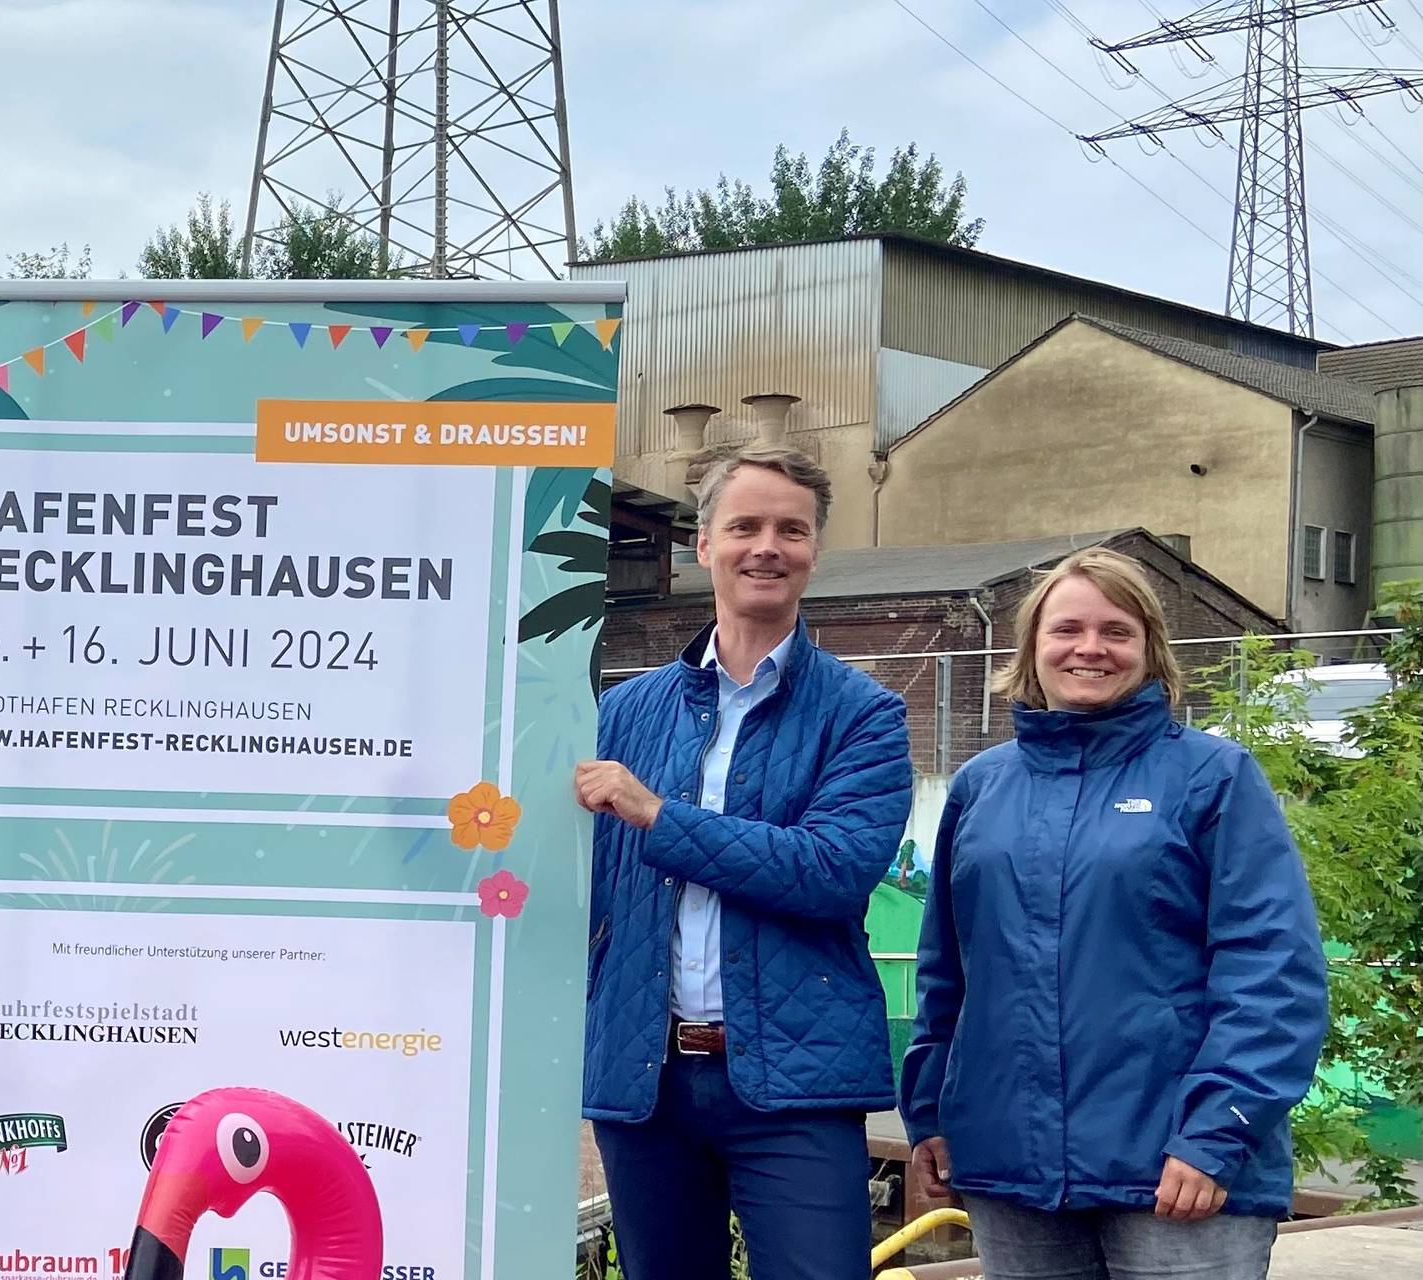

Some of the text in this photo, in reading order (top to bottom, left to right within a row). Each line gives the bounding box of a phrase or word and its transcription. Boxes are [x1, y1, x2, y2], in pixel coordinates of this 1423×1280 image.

[284, 421, 587, 447] UMSONST & DRAUSSEN!
[22, 635, 46, 660] +
[61, 624, 118, 665] 16.
[138, 626, 249, 667] JUNI
[271, 629, 378, 670] 2024
[104, 699, 312, 721] RECKLINGHAUSEN
[52, 943, 326, 961] Mit freundlicher Unterstützung unserer Partner:
[279, 1027, 442, 1056] westenergie
